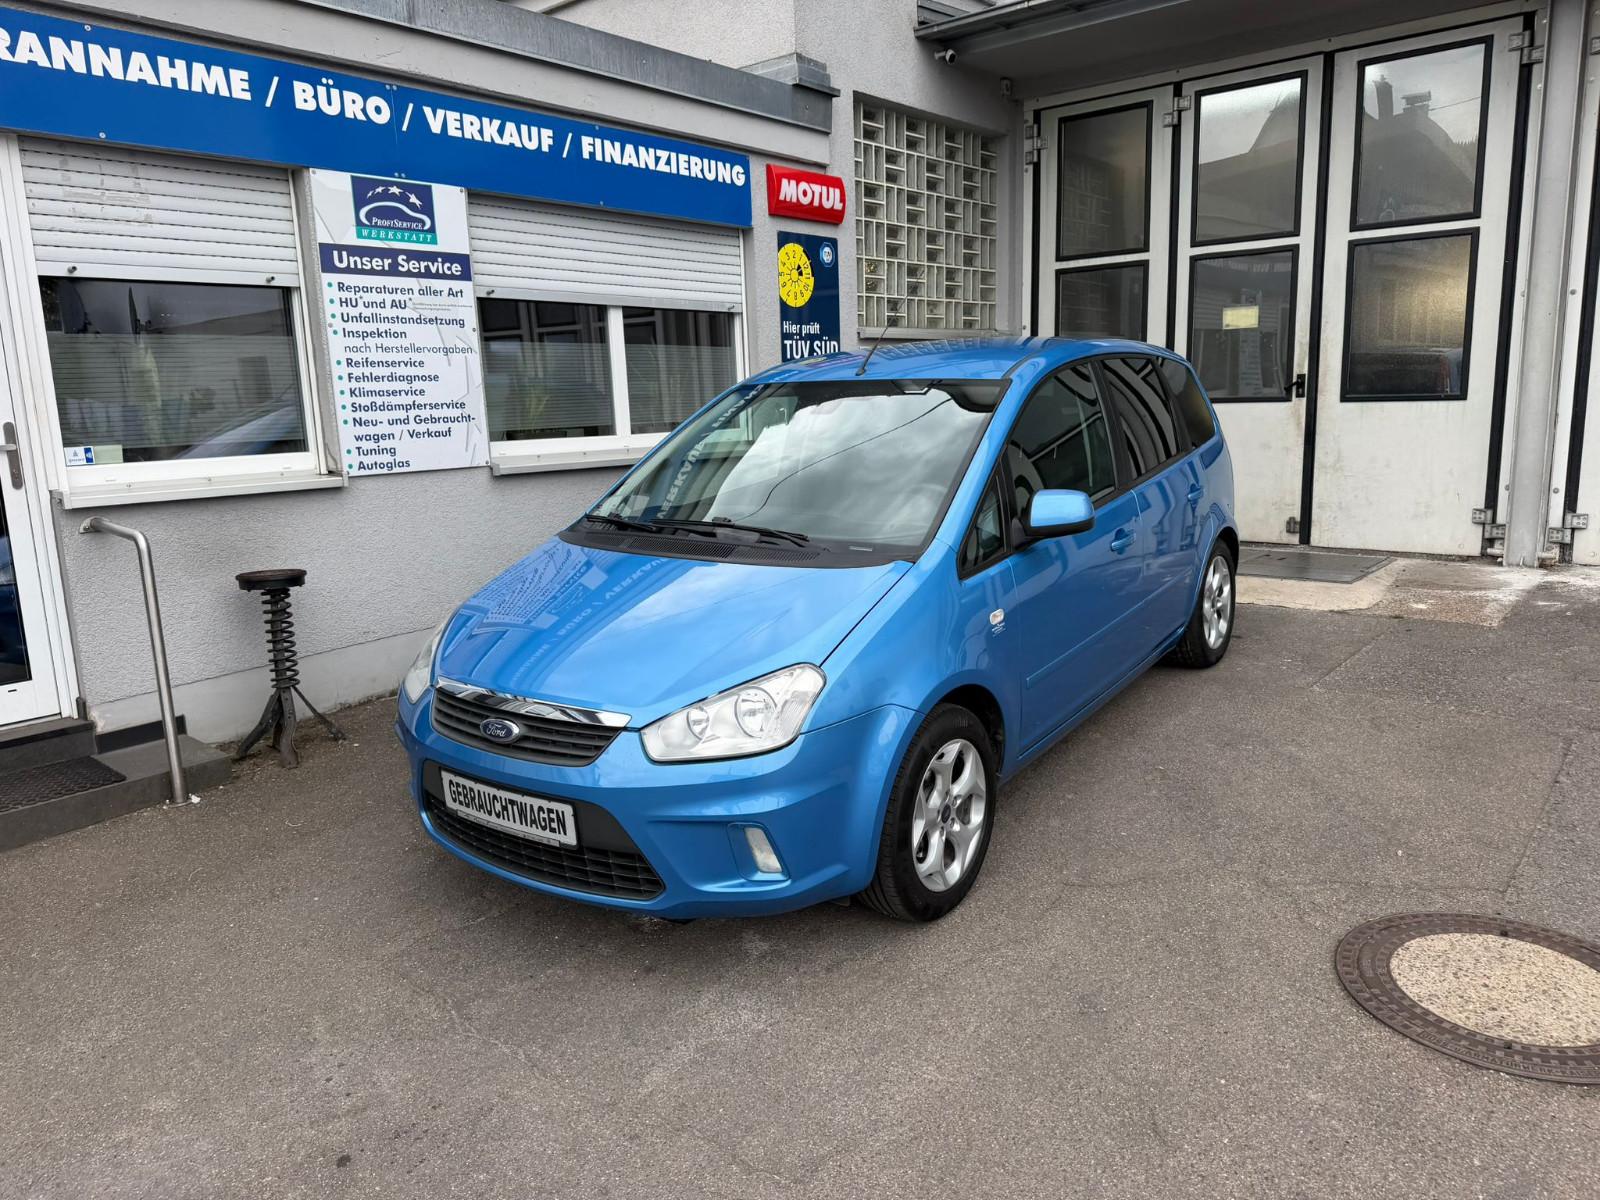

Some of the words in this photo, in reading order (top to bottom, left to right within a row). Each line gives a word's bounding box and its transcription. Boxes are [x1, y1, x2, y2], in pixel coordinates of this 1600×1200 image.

[293, 78, 391, 125] BÜRO
[422, 105, 553, 152] VERKAUF
[581, 135, 746, 186] FINANZIERUNG
[779, 177, 843, 210] MOTUL
[361, 228, 433, 242] WERKSTATT
[332, 250, 392, 271] Unser
[397, 254, 462, 275] Service
[337, 281, 415, 296] Reparaturen
[418, 283, 444, 297] aller
[447, 287, 464, 298] Art
[363, 298, 386, 309] und
[340, 312, 465, 328] Unfallinstandsetzung
[342, 327, 407, 341] Inspektion
[783, 320, 800, 334] Hier
[801, 322, 820, 337] prüft
[344, 342, 372, 353] nach
[375, 343, 473, 356] Herstellervorgaben
[784, 335, 810, 359] TÜV
[346, 357, 425, 369] Reifenservice
[347, 372, 440, 384] Fehlerdiagnose
[349, 386, 426, 398] Klimaservice
[351, 400, 466, 413] Stoßdämpferservice
[352, 416, 384, 427] Neu-
[388, 415, 410, 426] und
[413, 413, 476, 425] Gebraucht-
[354, 431, 395, 443] wagen
[407, 427, 452, 439] Verkauf
[355, 446, 397, 457] Tuning
[357, 459, 411, 471] Autoglas
[485, 724, 507, 738] Ford
[448, 779, 568, 836] GEBRAUCHTWAGEN
